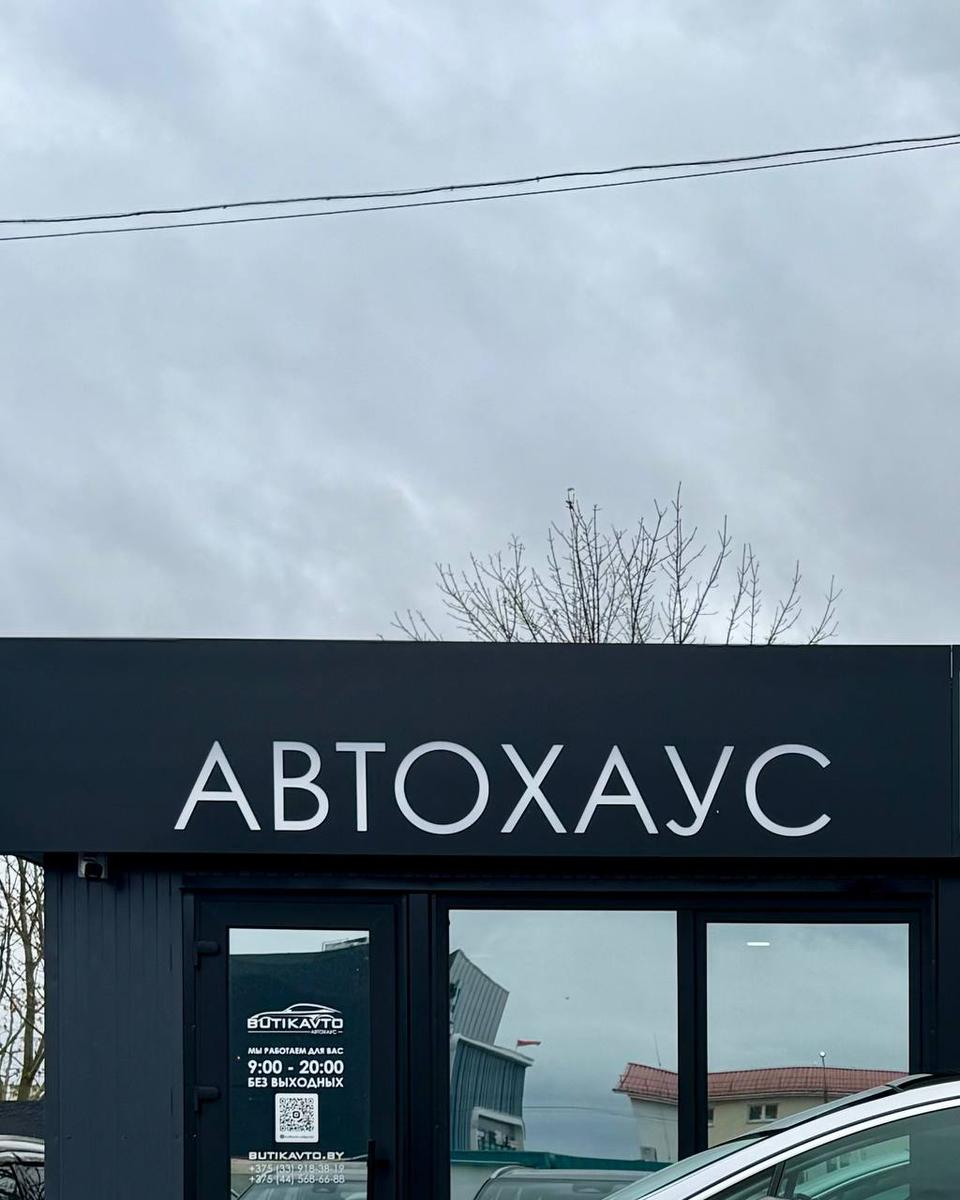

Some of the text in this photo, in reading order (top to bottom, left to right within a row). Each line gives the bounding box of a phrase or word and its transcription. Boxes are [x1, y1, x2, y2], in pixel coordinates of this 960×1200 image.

[174, 741, 831, 837] АВТОХАУС
[247, 1018, 343, 1029] BUTIKAVTO
[248, 1047, 344, 1056] МЫ РАБОТАЕМ ДЛЯ ВАС
[248, 1059, 283, 1074] 9:00
[299, 1059, 345, 1074] 20:00
[247, 1077, 344, 1089] БЕЗ ВЫХОДНЫХ
[248, 1151, 345, 1160] BUTIKAVTO.BY
[276, 1164, 294, 1174] (33)
[276, 1174, 294, 1185] (44)
[297, 1174, 345, 1184] 568-66-88
